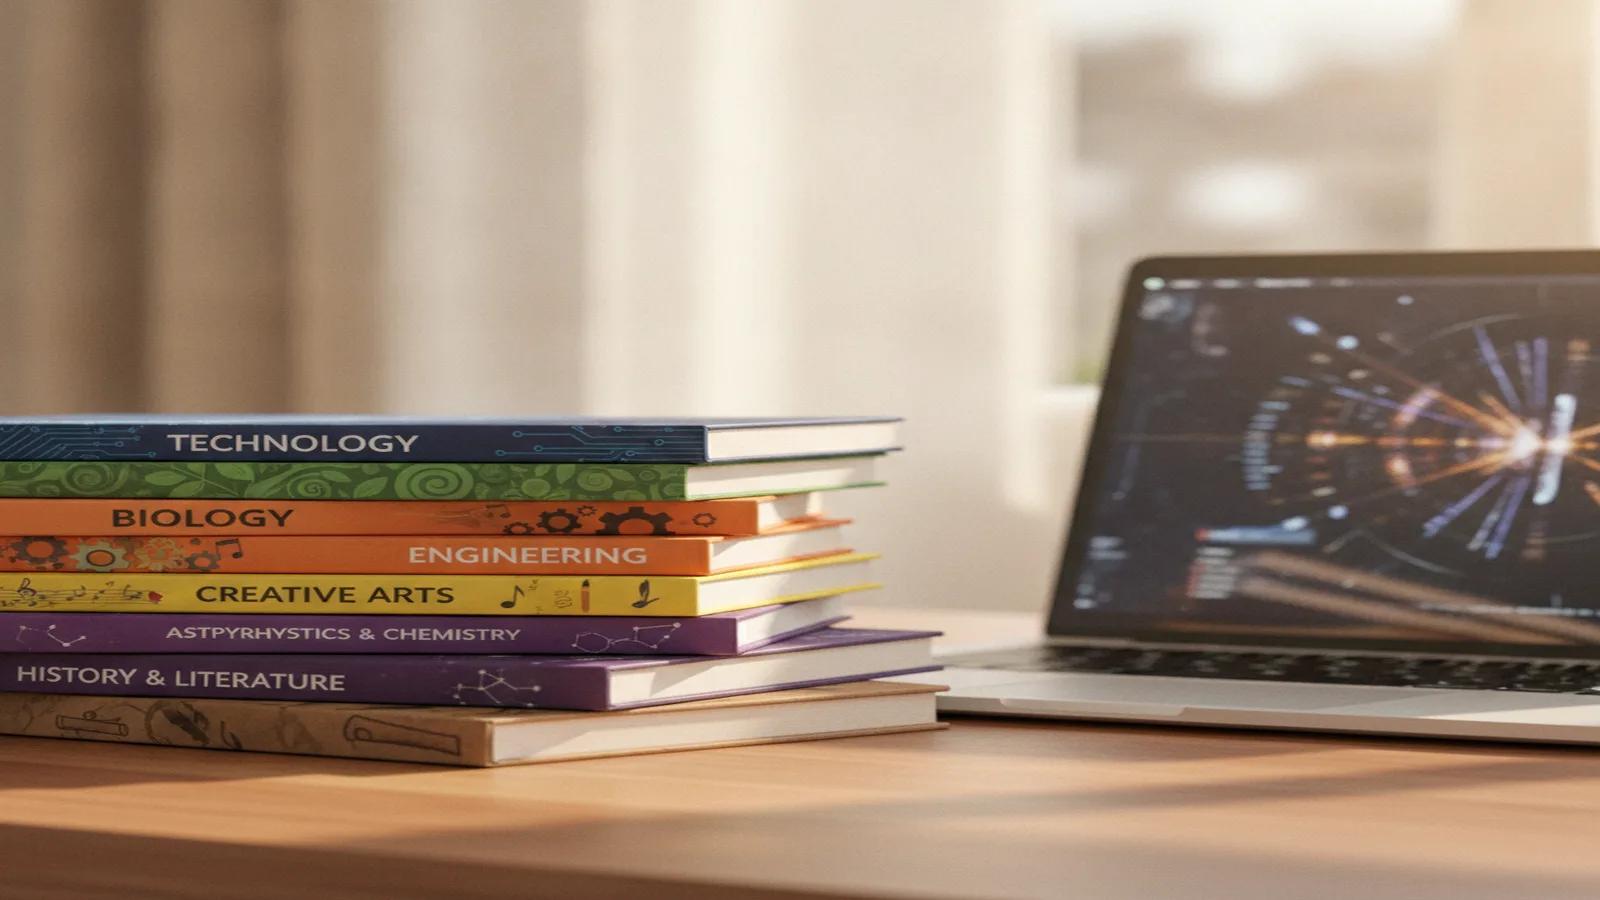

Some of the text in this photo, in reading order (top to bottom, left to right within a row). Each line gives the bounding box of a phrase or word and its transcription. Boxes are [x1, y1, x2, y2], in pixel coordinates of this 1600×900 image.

[167, 434, 419, 453] TECHNOLOGY
[112, 508, 294, 528] BIOLOGY
[408, 546, 647, 565] ENGINEERING
[196, 585, 455, 604] CREATIVE ARTS
[165, 626, 521, 641] ASTPYRHYSTICS & CHEMISTRY
[17, 666, 345, 691] HISTORY & LITERATURE
